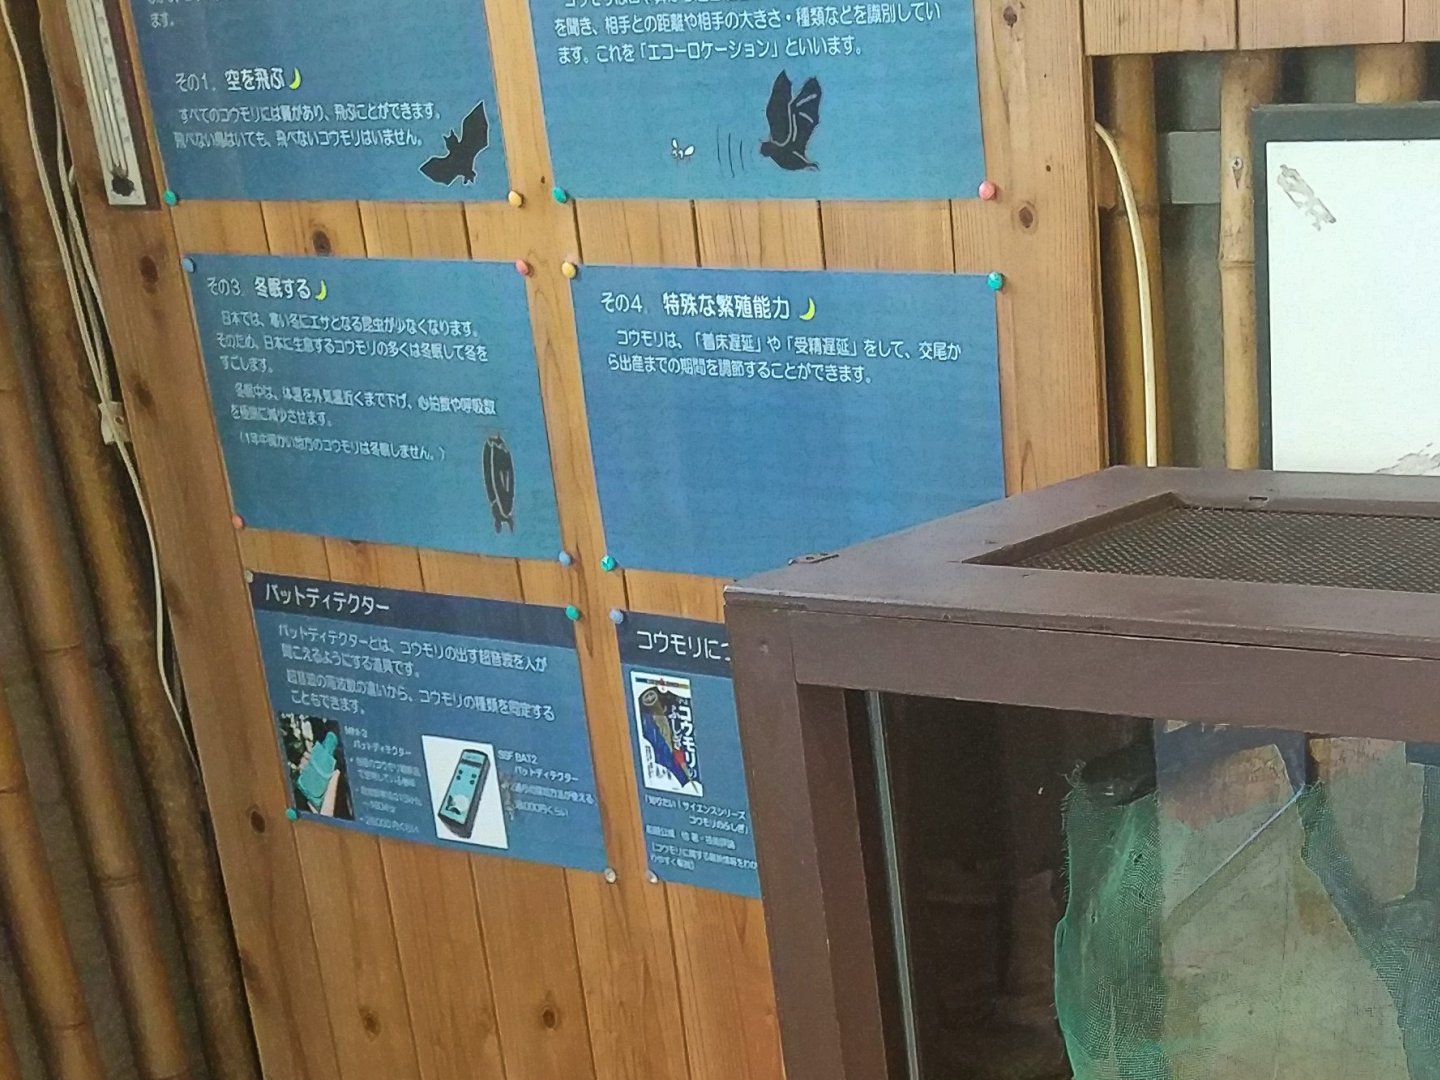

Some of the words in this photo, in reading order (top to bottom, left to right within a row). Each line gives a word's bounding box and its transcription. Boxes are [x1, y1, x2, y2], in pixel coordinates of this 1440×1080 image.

[224, 67, 285, 91] 空を飛ぶ
[254, 276, 312, 299] 冬眠する
[662, 292, 791, 320] 特殊な繁殖能力
[265, 583, 390, 616] バットディテクター
